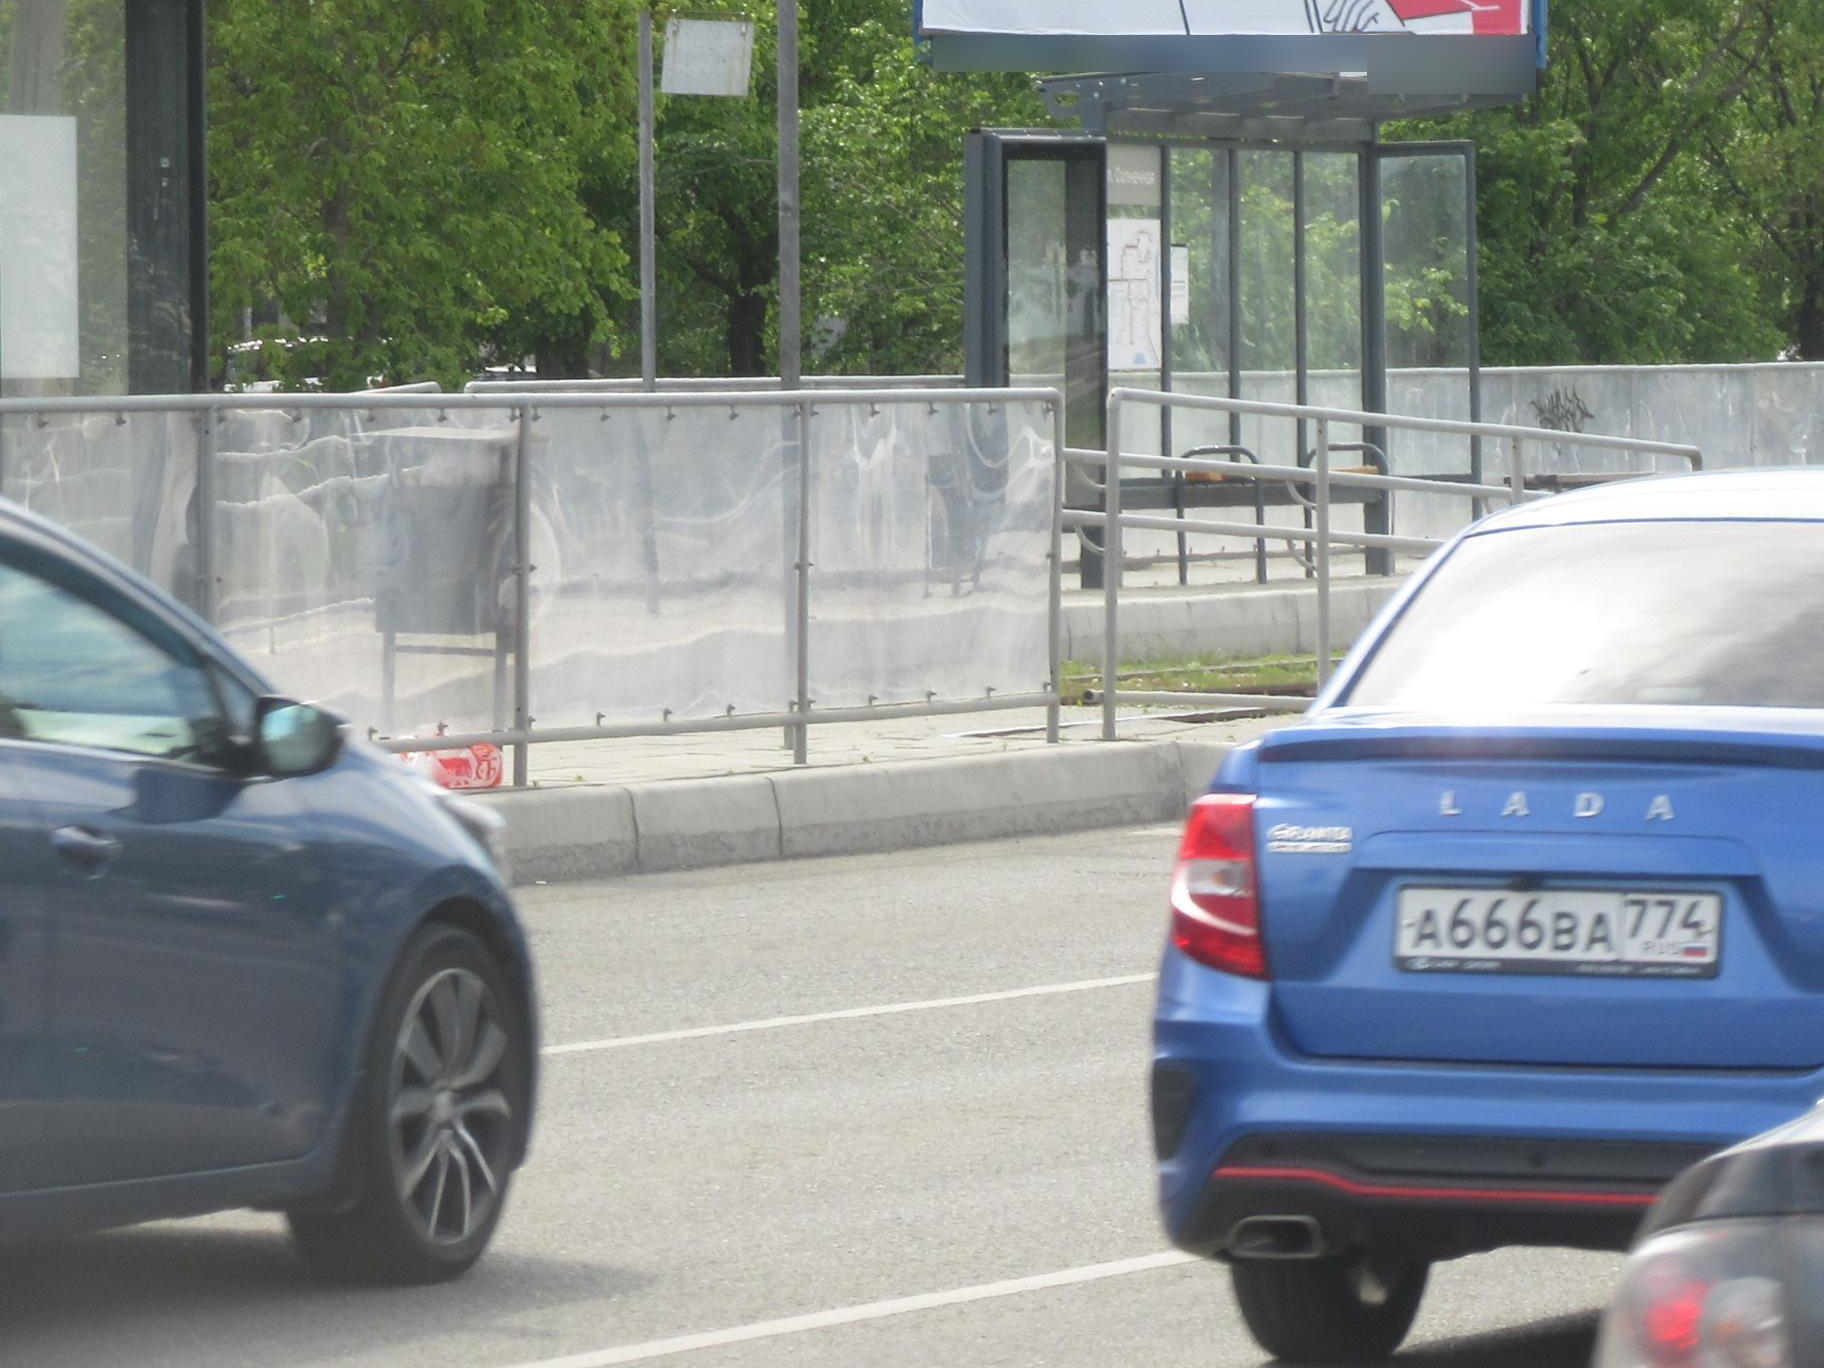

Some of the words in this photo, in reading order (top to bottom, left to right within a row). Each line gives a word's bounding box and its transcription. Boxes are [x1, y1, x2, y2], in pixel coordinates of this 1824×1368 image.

[1439, 790, 1676, 821] LADA
[1624, 898, 1703, 939] 774
[1641, 941, 1680, 955] RUS
